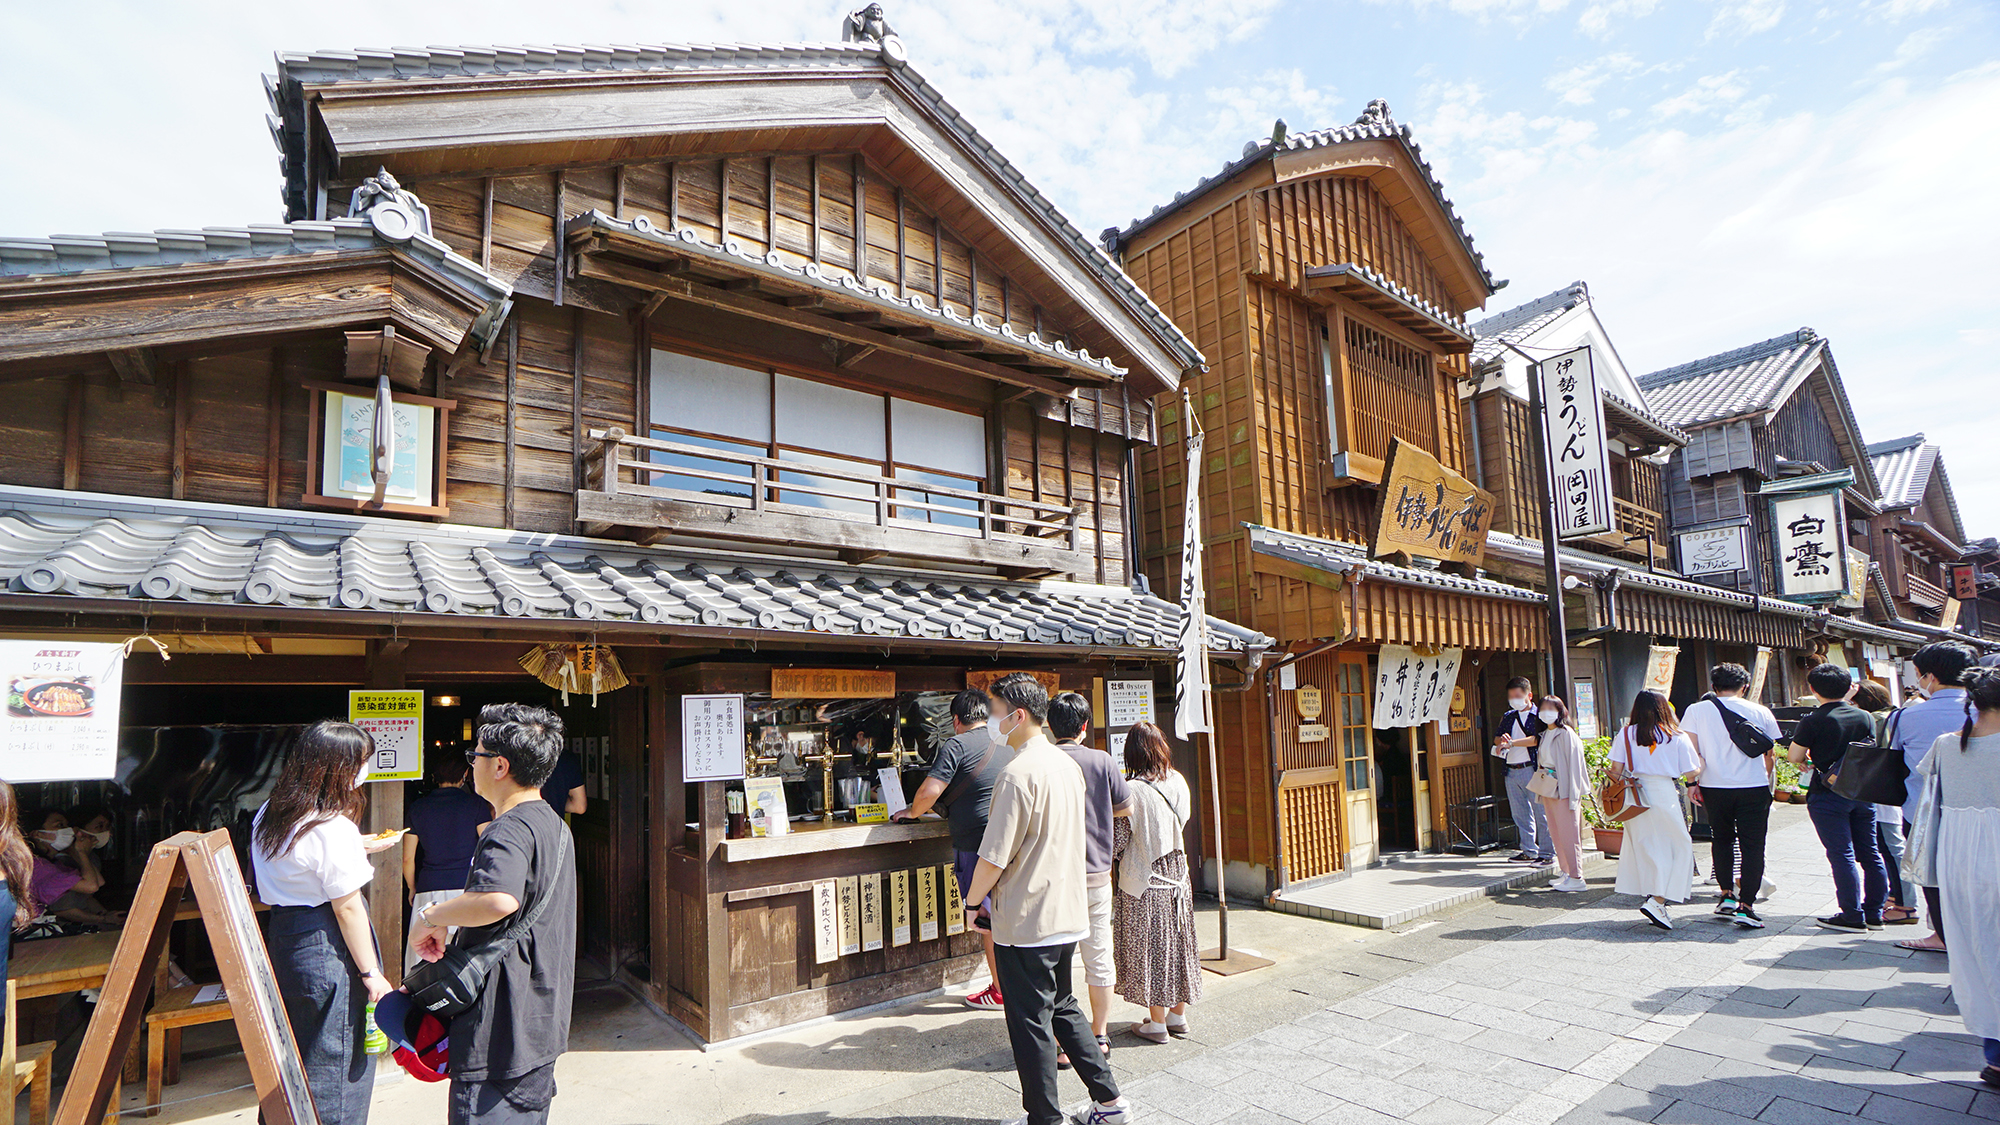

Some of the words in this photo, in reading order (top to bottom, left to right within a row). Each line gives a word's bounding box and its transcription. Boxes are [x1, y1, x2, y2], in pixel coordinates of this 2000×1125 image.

[391, 407, 411, 428] EER
[1556, 358, 1587, 463] 伊勢うどん
[1567, 469, 1591, 528] 岡田屋
[1686, 529, 1734, 542] COFFEE
[1785, 513, 1834, 577] 白鷹
[33, 661, 82, 672] ひつまぶし
[775, 674, 807, 692] CRAFT
[812, 674, 837, 692] BEER
[842, 675, 848, 691] &
[852, 674, 893, 692] OYSTERS
[1111, 682, 1125, 690] 牡蠣
[1391, 657, 1409, 720] 丼物
[1422, 658, 1440, 717] うどん
[356, 702, 417, 710] 感染症対策中
[694, 715, 702, 775] お声掛けください。
[703, 700, 712, 771] 御用の方はスタッフに
[716, 714, 724, 759] 奥にあります。
[821, 888, 831, 946] 飲み比べセット
[863, 881, 873, 924] 神都麦酒
[898, 874, 906, 925] カキフライ串
[924, 871, 934, 920] カキフライ串
